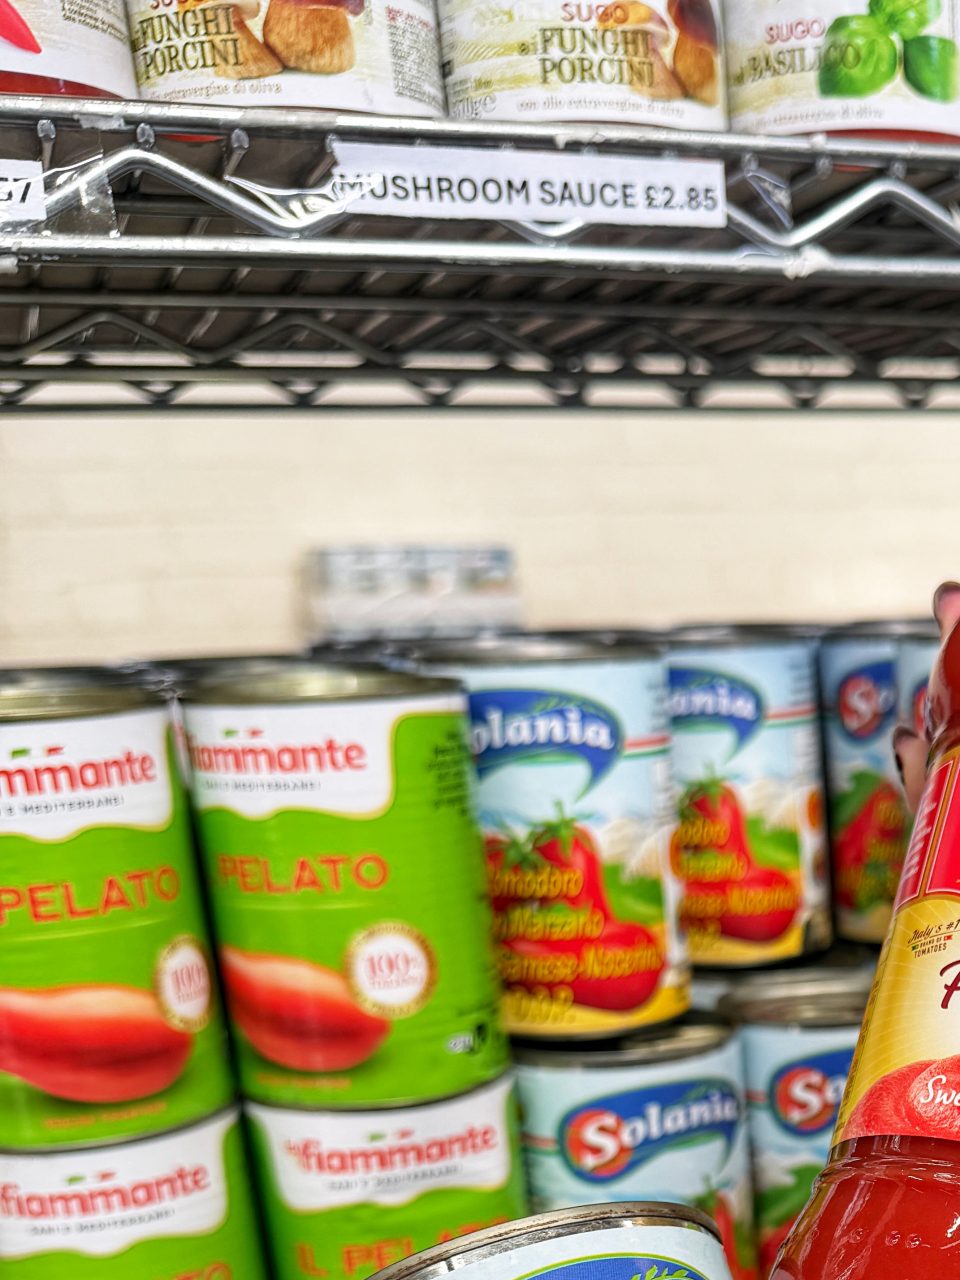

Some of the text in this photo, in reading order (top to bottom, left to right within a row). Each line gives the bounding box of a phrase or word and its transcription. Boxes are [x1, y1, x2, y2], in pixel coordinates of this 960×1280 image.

[138, 6, 237, 51] FUNGHI
[561, 2, 630, 23] SUGO
[765, 18, 825, 44] SUGO
[143, 38, 244, 79] PORCINI
[539, 27, 653, 55] FUNGHI
[539, 57, 655, 85] PORCINI
[338, 173, 719, 212] MUSHROOM SAUCE £2.85
[217, 852, 390, 895] PELATO
[0, 864, 180, 926] PELATO
[914, 942, 948, 959] TOMATOES
[301, 1124, 498, 1175] fiammante
